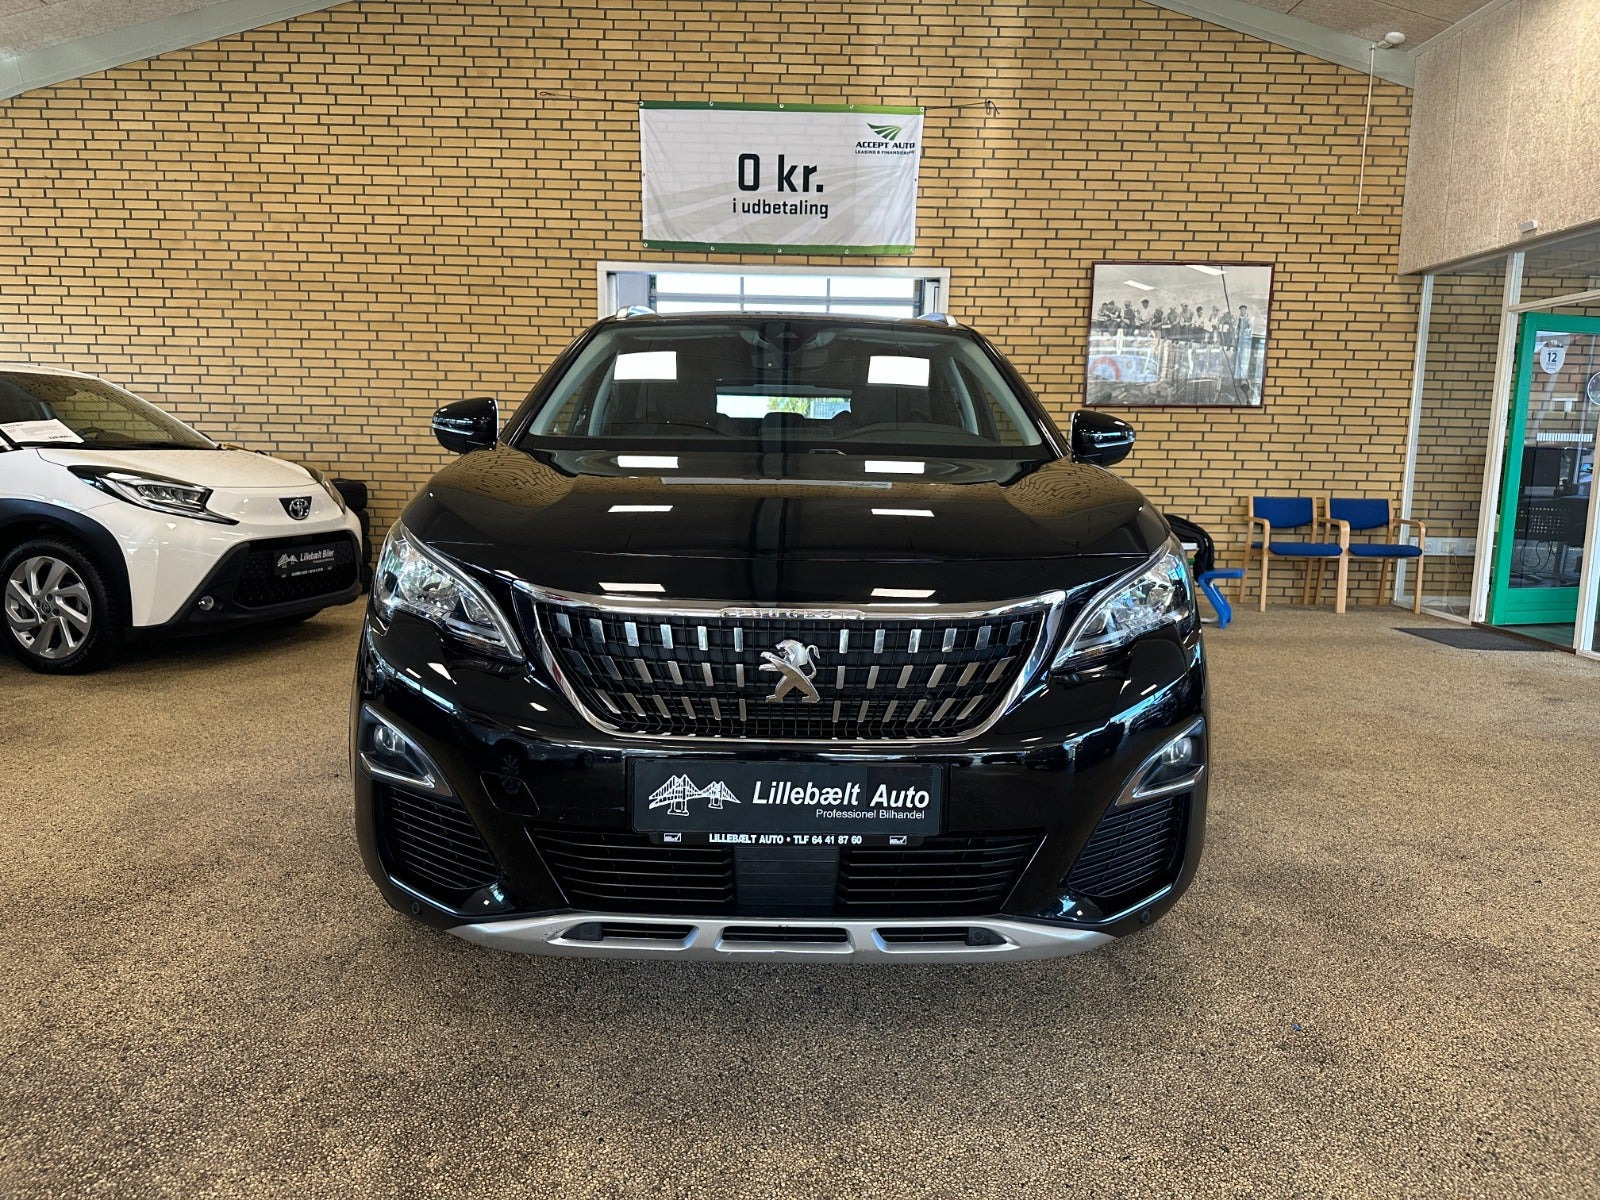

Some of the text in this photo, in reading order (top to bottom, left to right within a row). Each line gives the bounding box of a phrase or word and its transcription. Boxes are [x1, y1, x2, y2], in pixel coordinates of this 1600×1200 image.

[738, 153, 824, 193] 0 kr.
[733, 198, 829, 219] i udbetaling
[1547, 352, 1557, 362] 12
[752, 780, 930, 809] Lillebælt Auto
[815, 808, 925, 820] Professionel Bilhandel
[708, 833, 862, 845] LILLEBÆLT AUTO TLF 64 41 87 60
